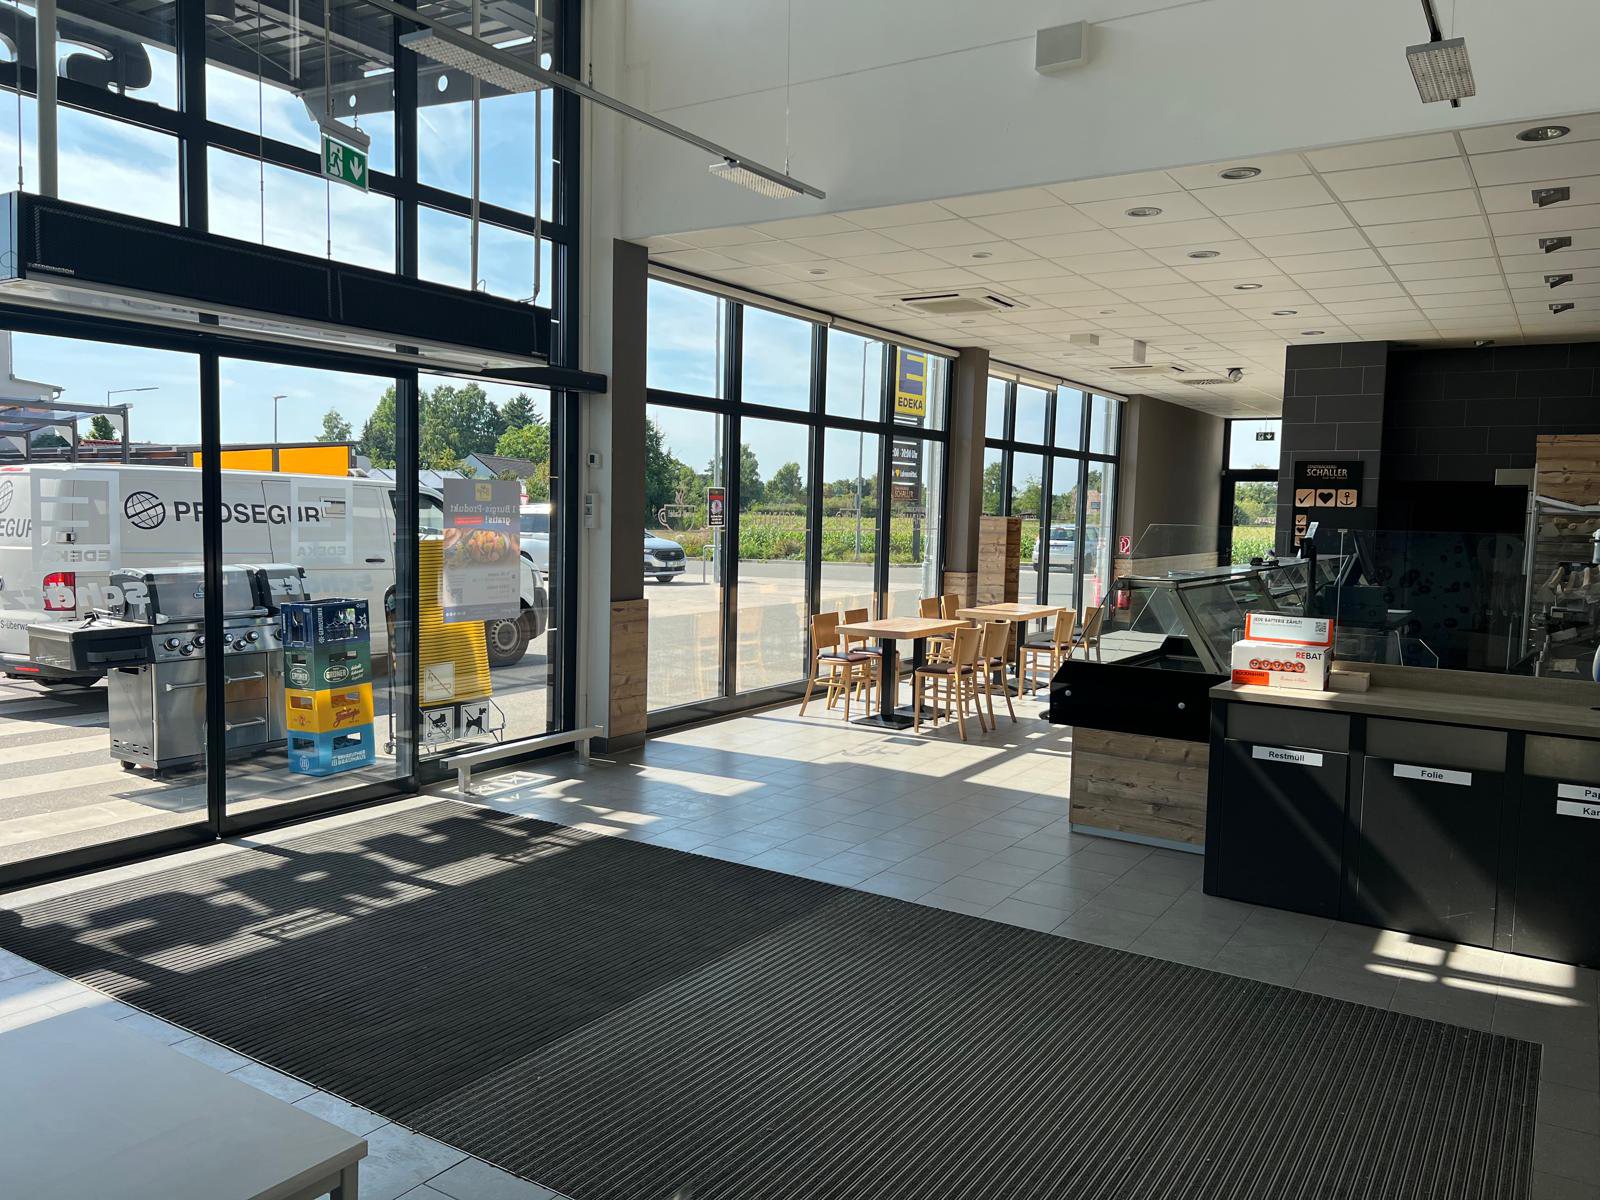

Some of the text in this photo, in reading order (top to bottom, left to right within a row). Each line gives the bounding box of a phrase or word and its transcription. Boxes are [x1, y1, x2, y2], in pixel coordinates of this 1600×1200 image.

[897, 397, 923, 410] EDEKA
[1306, 468, 1348, 477] SCHALLER
[1295, 651, 1322, 660] REBAT
[1268, 750, 1305, 762] Restmüll
[1420, 770, 1444, 780] Folie
